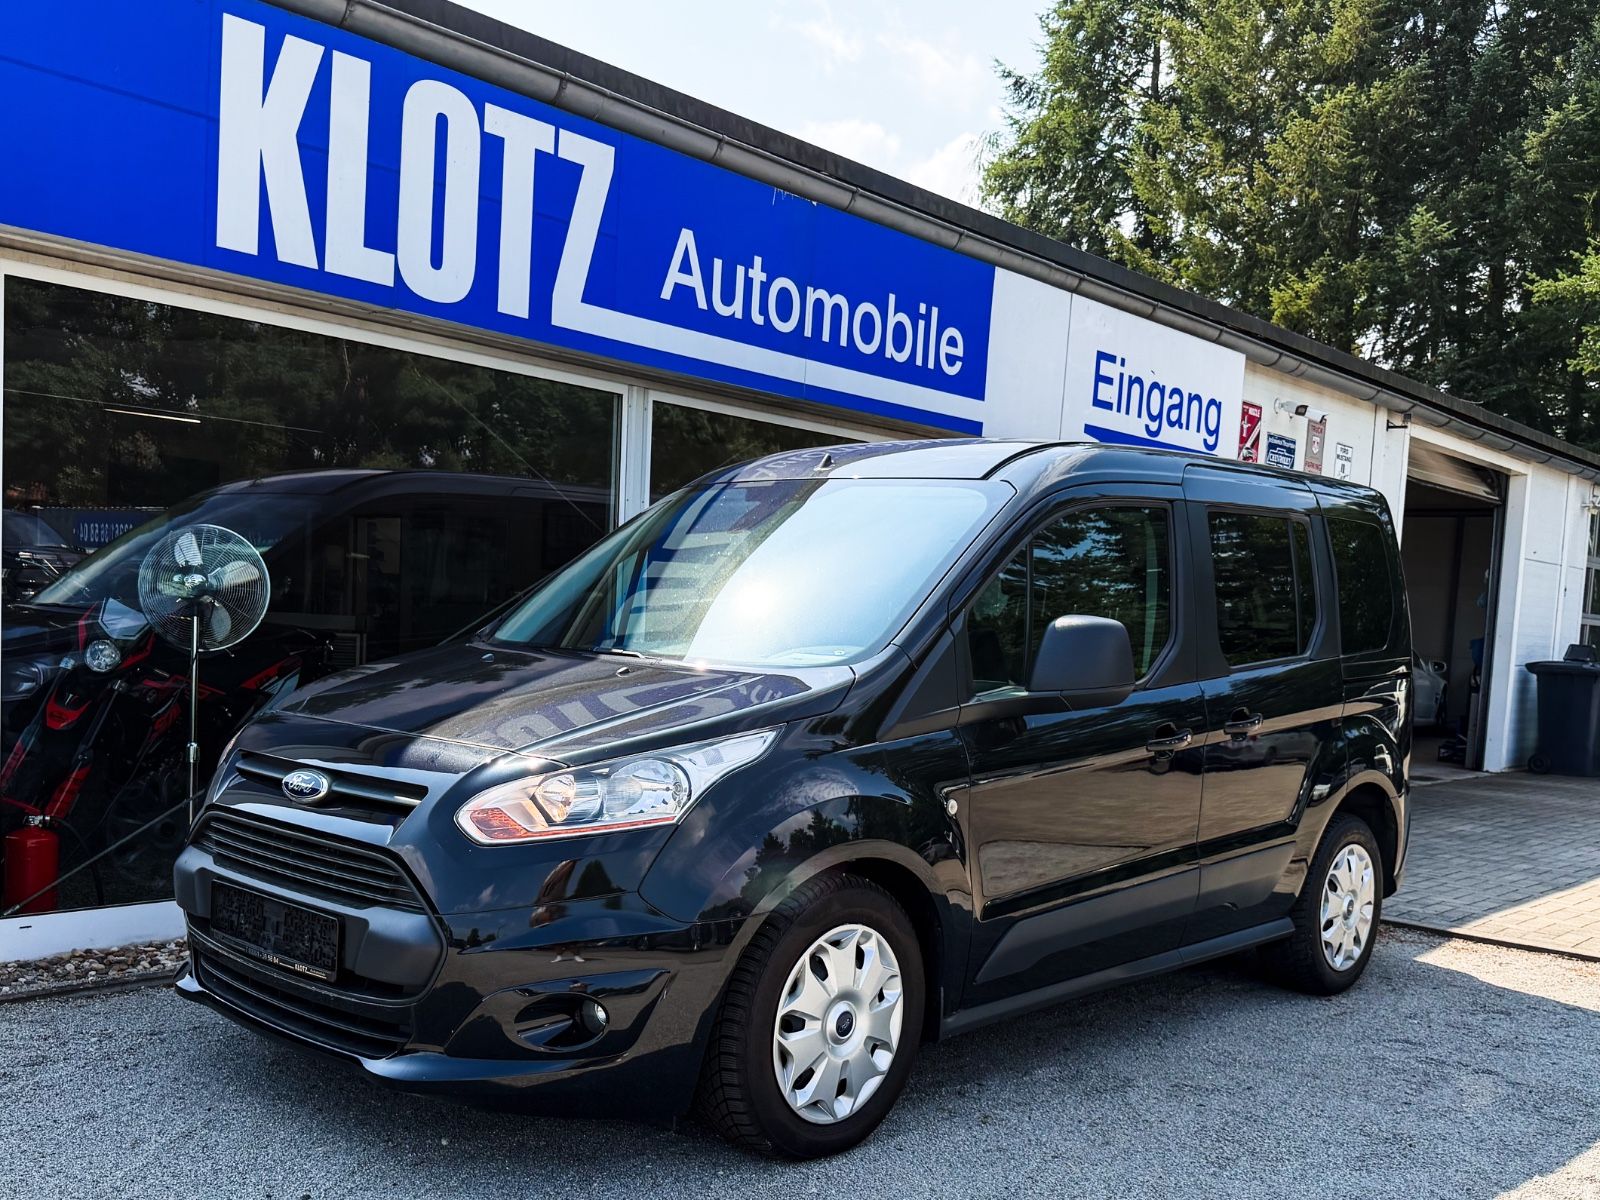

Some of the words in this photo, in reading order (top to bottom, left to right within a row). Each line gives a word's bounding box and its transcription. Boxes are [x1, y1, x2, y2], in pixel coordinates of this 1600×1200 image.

[216, 13, 615, 325] KLOTZ
[660, 228, 964, 376] Automobile
[1092, 350, 1222, 451] Eingang
[288, 773, 316, 794] Ford
